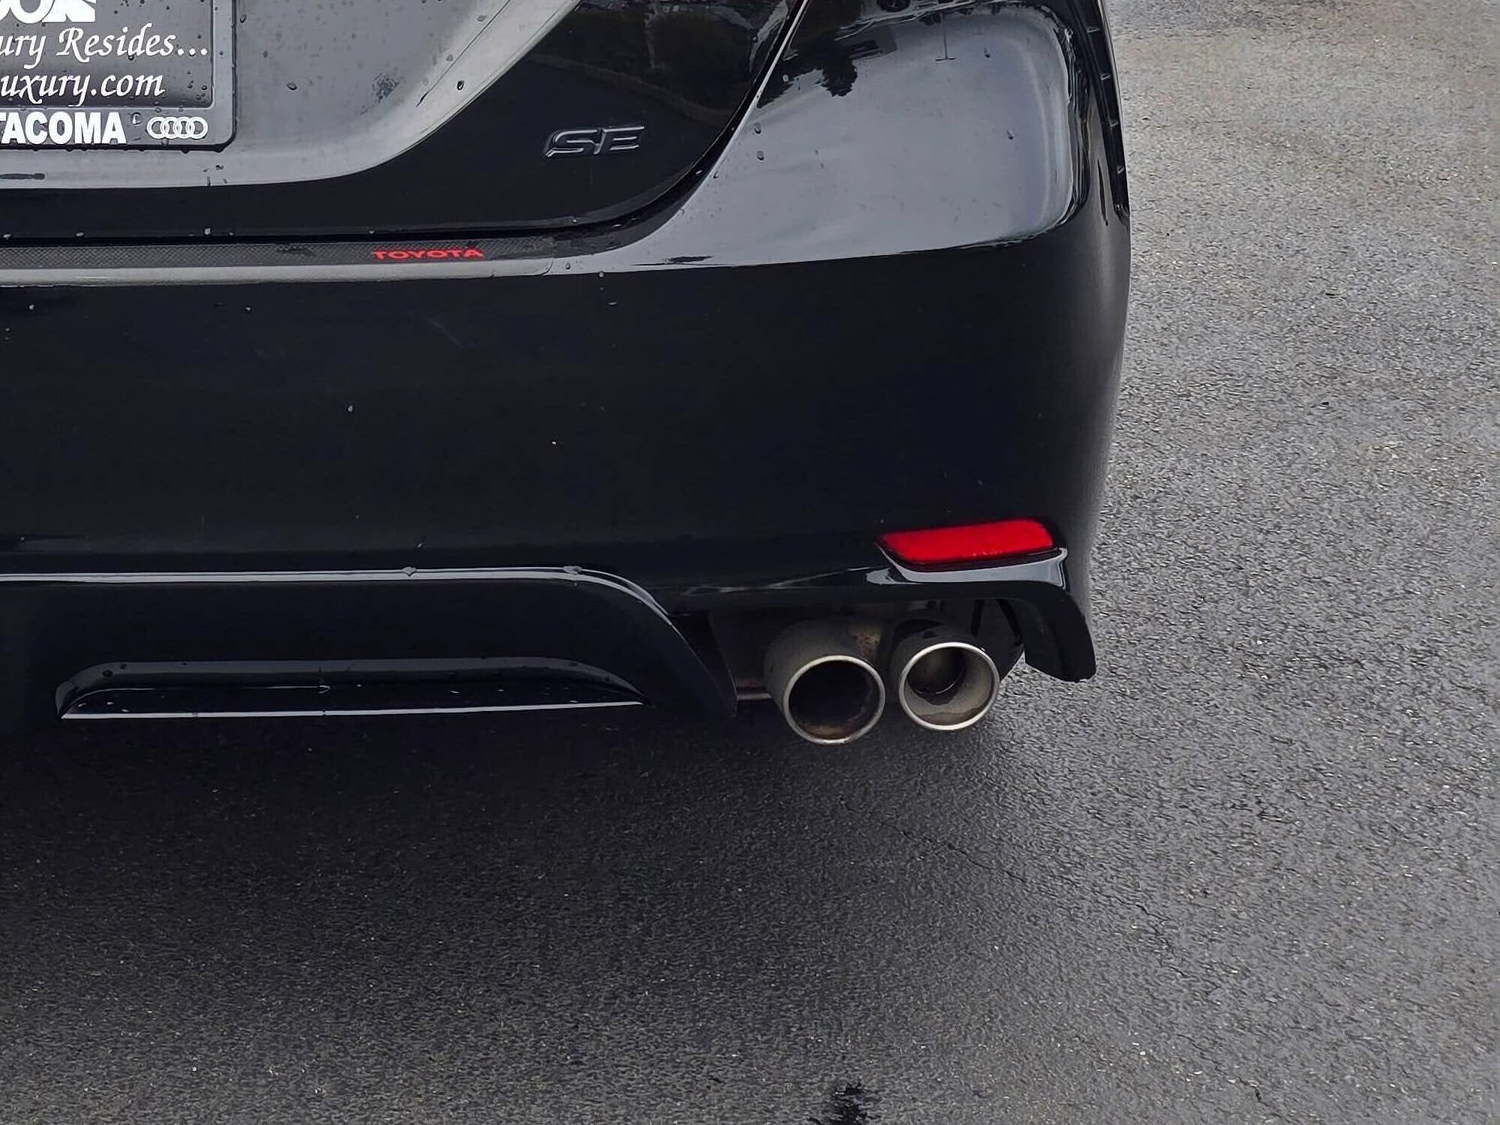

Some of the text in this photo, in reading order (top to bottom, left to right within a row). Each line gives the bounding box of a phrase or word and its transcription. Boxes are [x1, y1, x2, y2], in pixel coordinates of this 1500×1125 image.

[56, 22, 208, 63] Resides...
[542, 126, 645, 158] SE
[372, 248, 485, 261] TOYOTA
